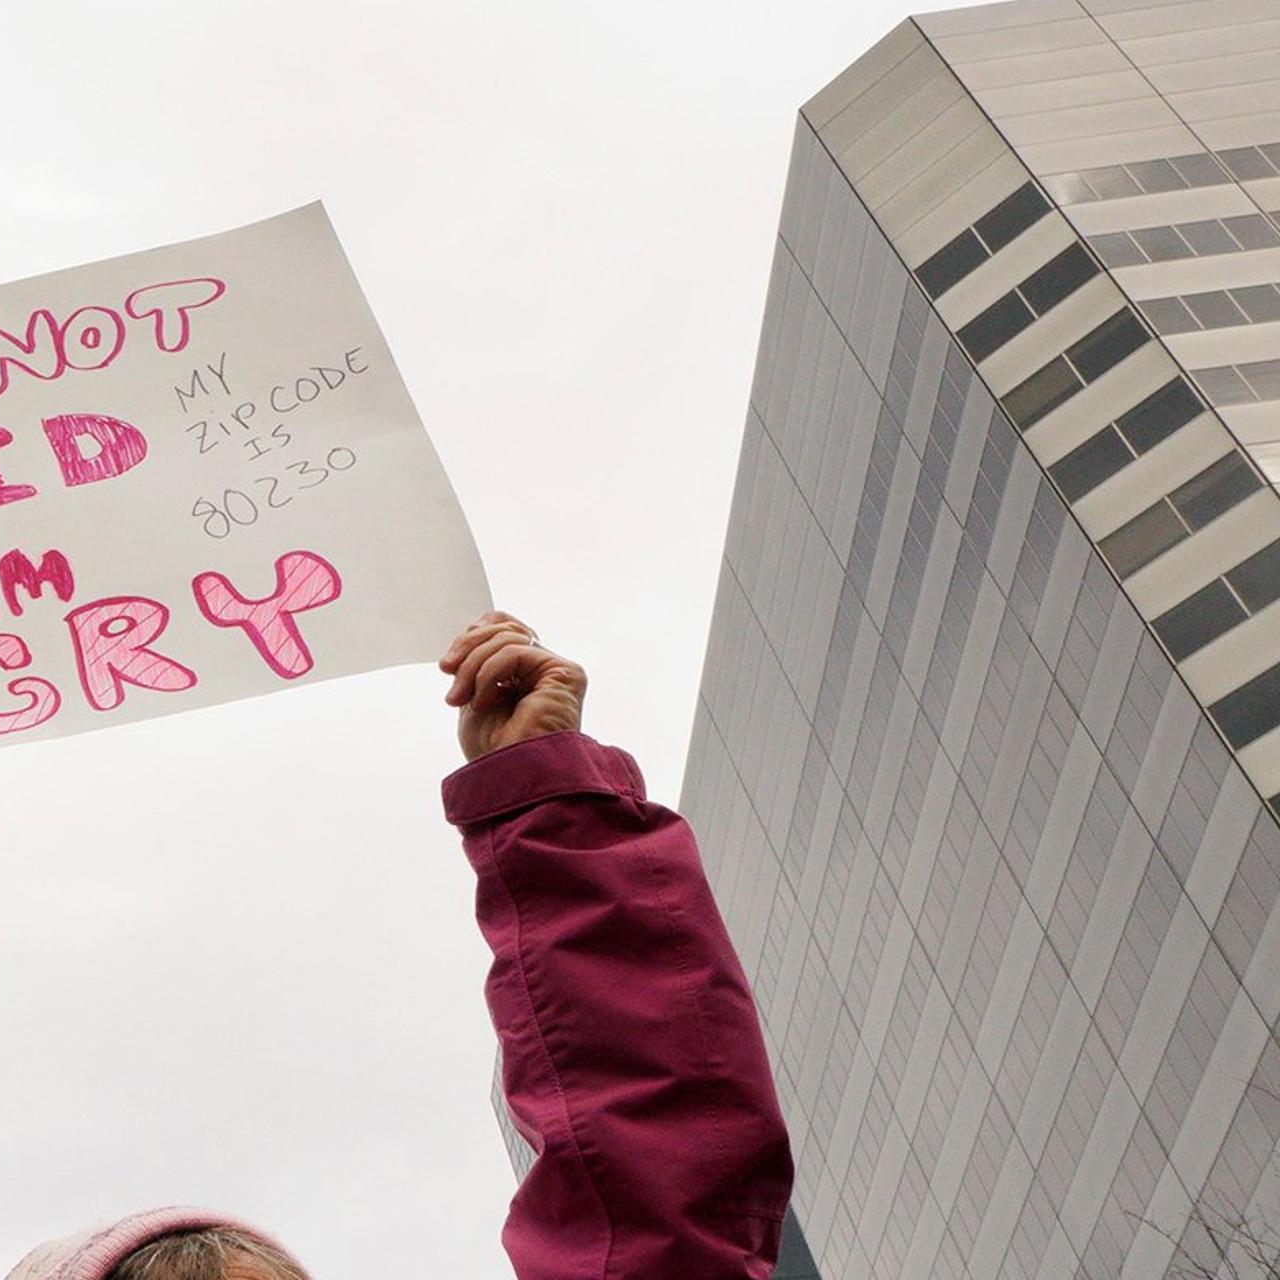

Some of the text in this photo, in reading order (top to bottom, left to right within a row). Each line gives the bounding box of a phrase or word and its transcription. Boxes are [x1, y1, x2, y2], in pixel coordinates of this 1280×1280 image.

[174, 352, 231, 413] MY
[270, 347, 370, 413] CODE
[243, 423, 291, 461] IS
[192, 447, 357, 539] 80230
